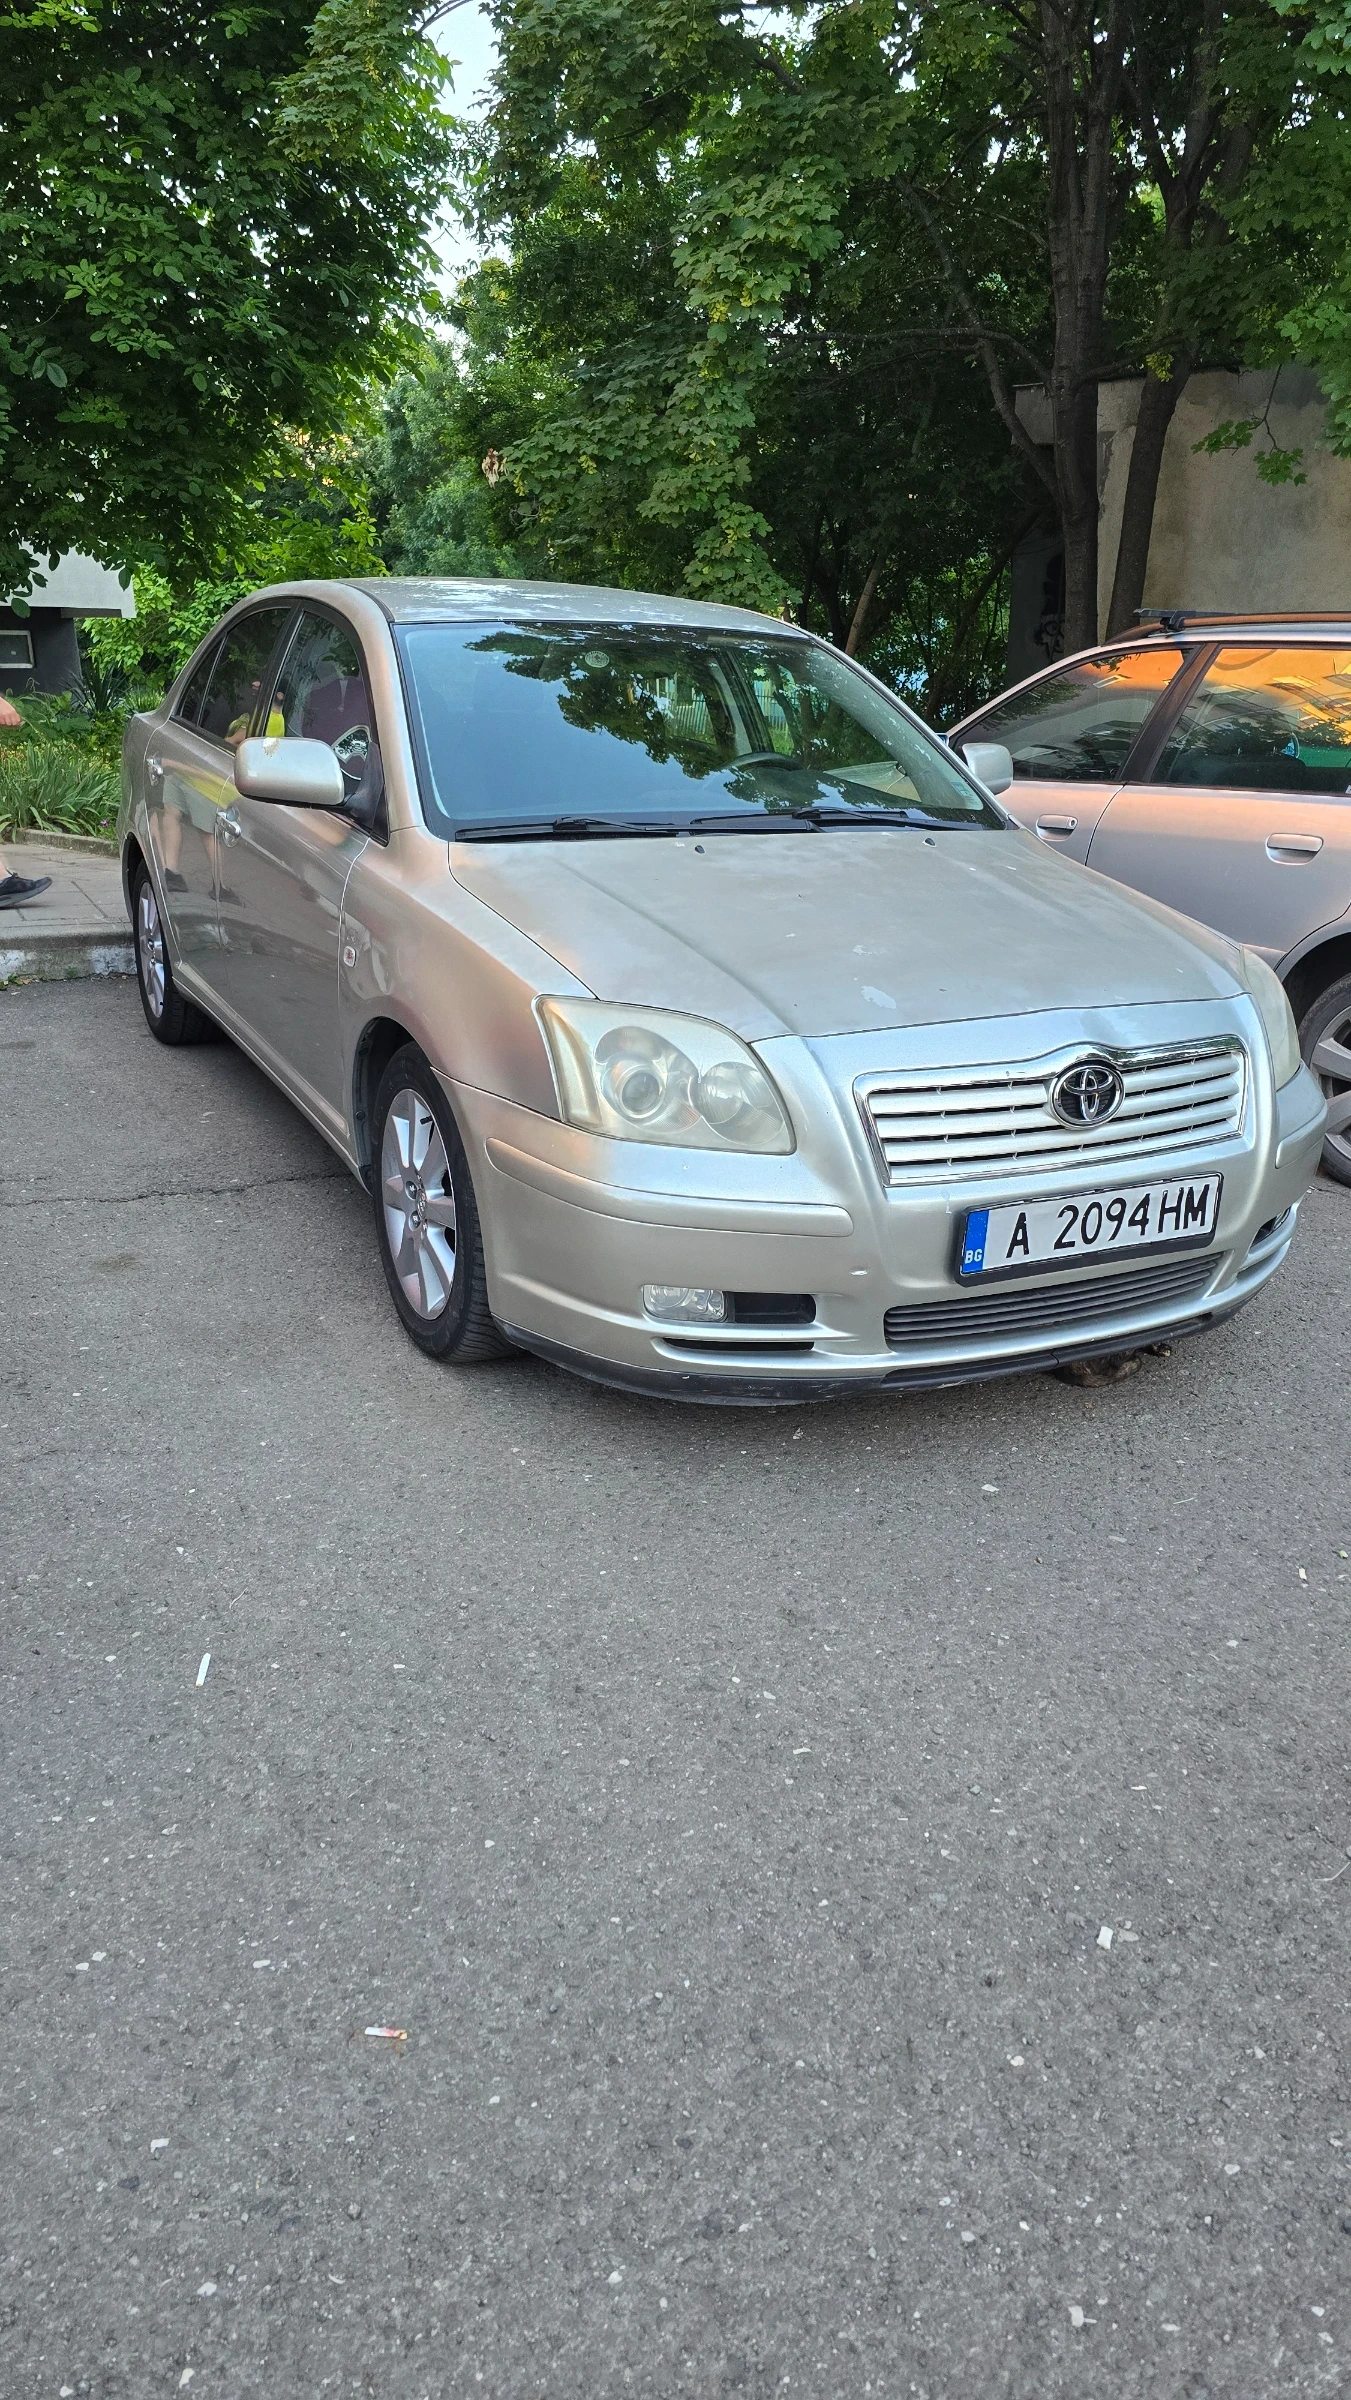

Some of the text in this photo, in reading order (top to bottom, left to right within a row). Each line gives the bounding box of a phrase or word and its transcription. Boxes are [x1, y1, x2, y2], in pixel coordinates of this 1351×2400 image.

[1006, 1183, 1210, 1258] A 2094 HM
[964, 1248, 983, 1264] BG
